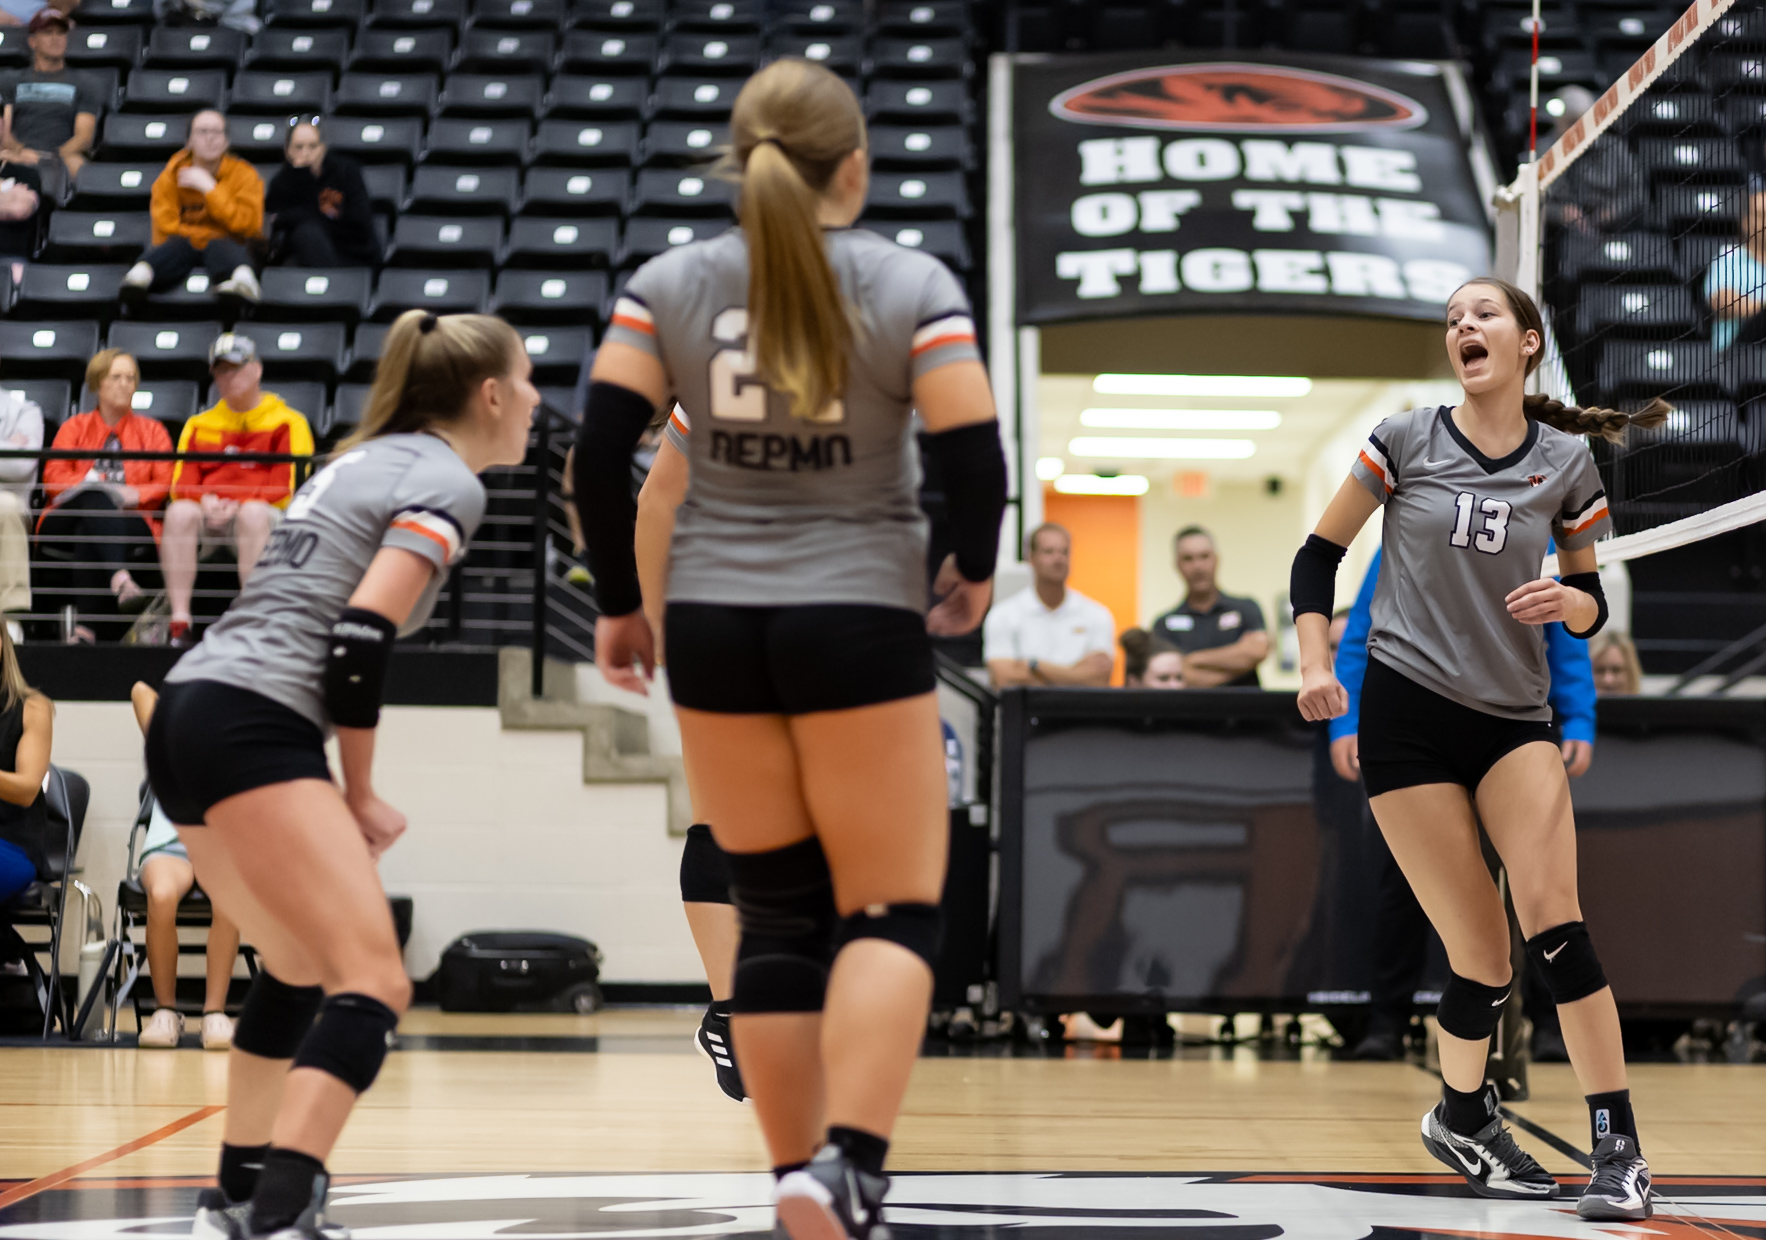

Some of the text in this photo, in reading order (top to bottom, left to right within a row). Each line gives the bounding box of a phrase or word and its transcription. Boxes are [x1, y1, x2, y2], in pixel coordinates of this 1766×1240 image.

[1078, 136, 1422, 193] HOME
[1071, 190, 1446, 241] OF THE
[1056, 247, 1470, 304] TIGERS
[1450, 490, 1513, 556] 13
